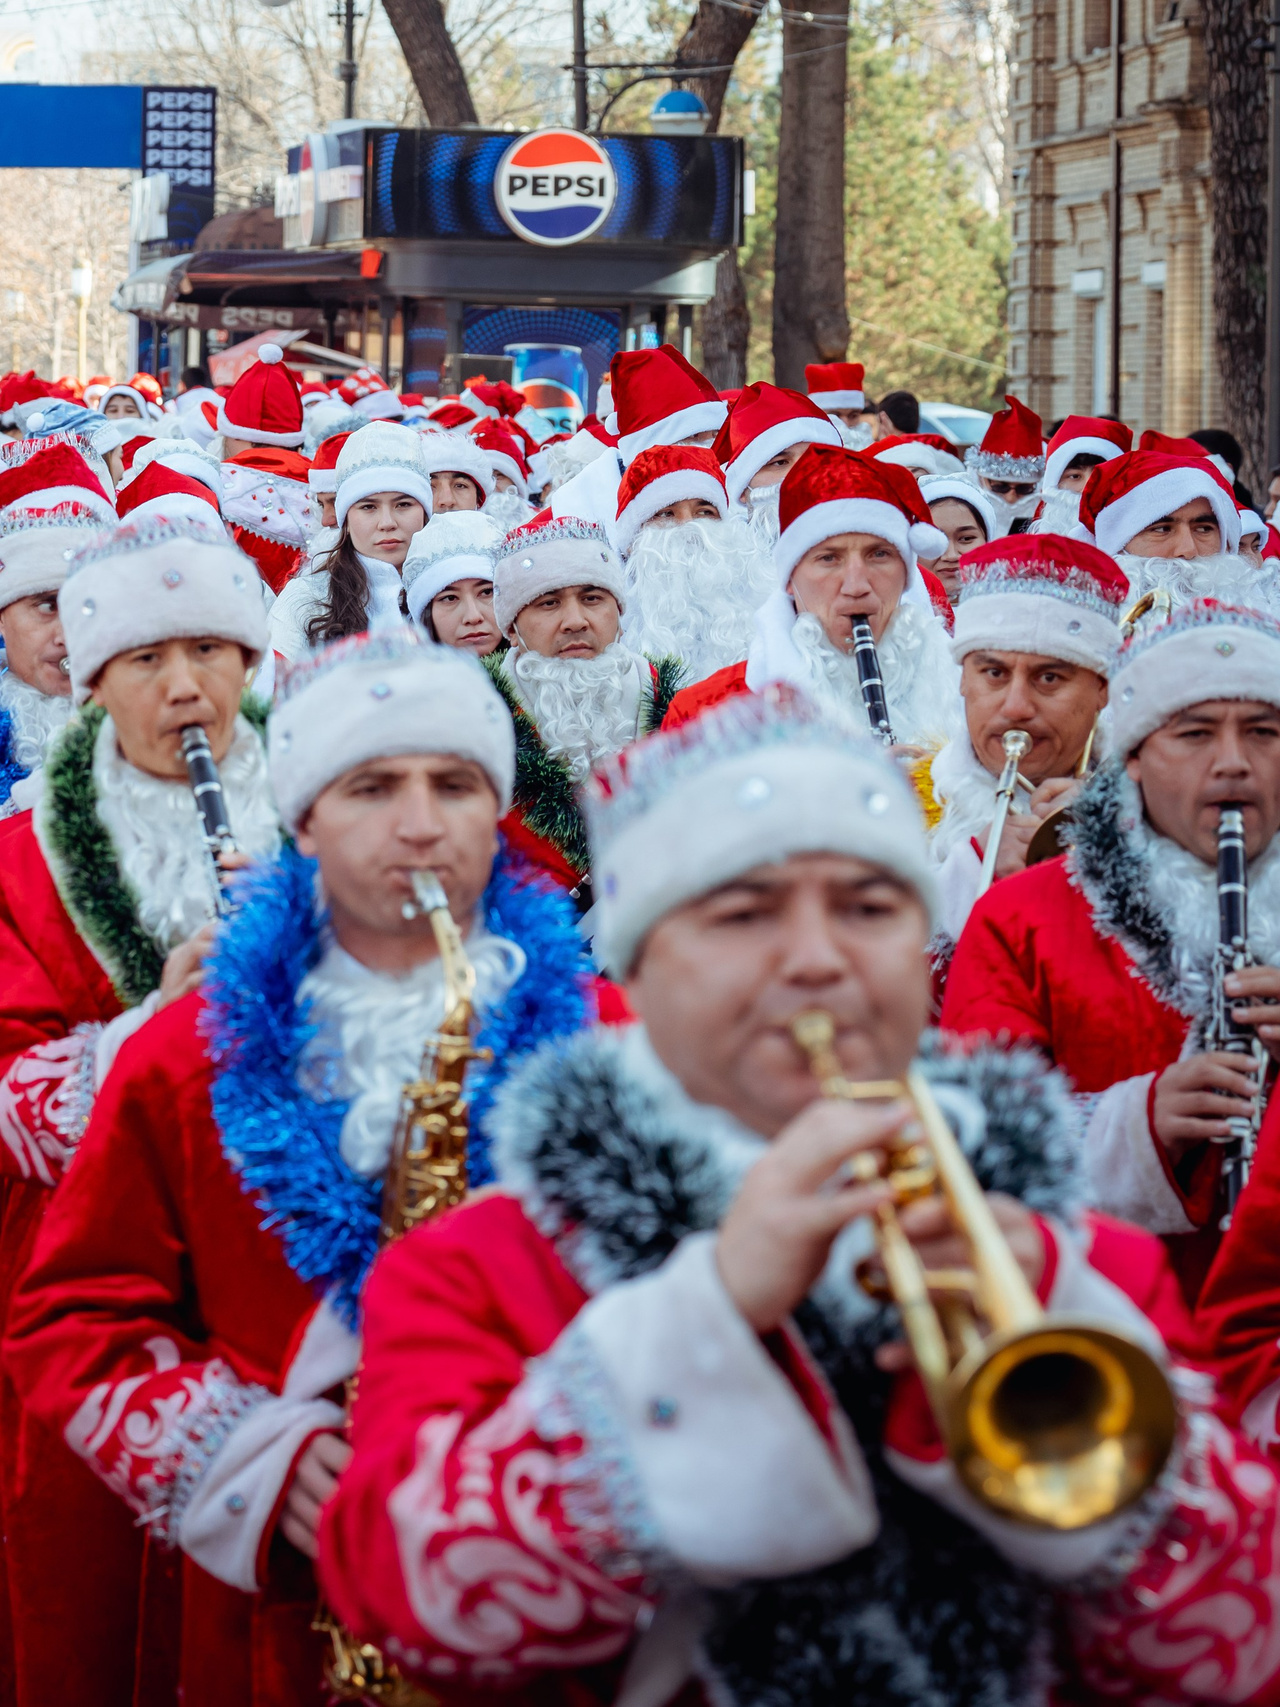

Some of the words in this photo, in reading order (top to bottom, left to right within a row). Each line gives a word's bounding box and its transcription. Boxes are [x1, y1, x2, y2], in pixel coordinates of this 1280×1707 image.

[146, 92, 213, 110] PEPSI
[146, 111, 213, 129] PEPSI
[146, 130, 213, 148] PEPSI
[146, 149, 213, 167] PEPSI
[509, 175, 605, 197] PEPSI
